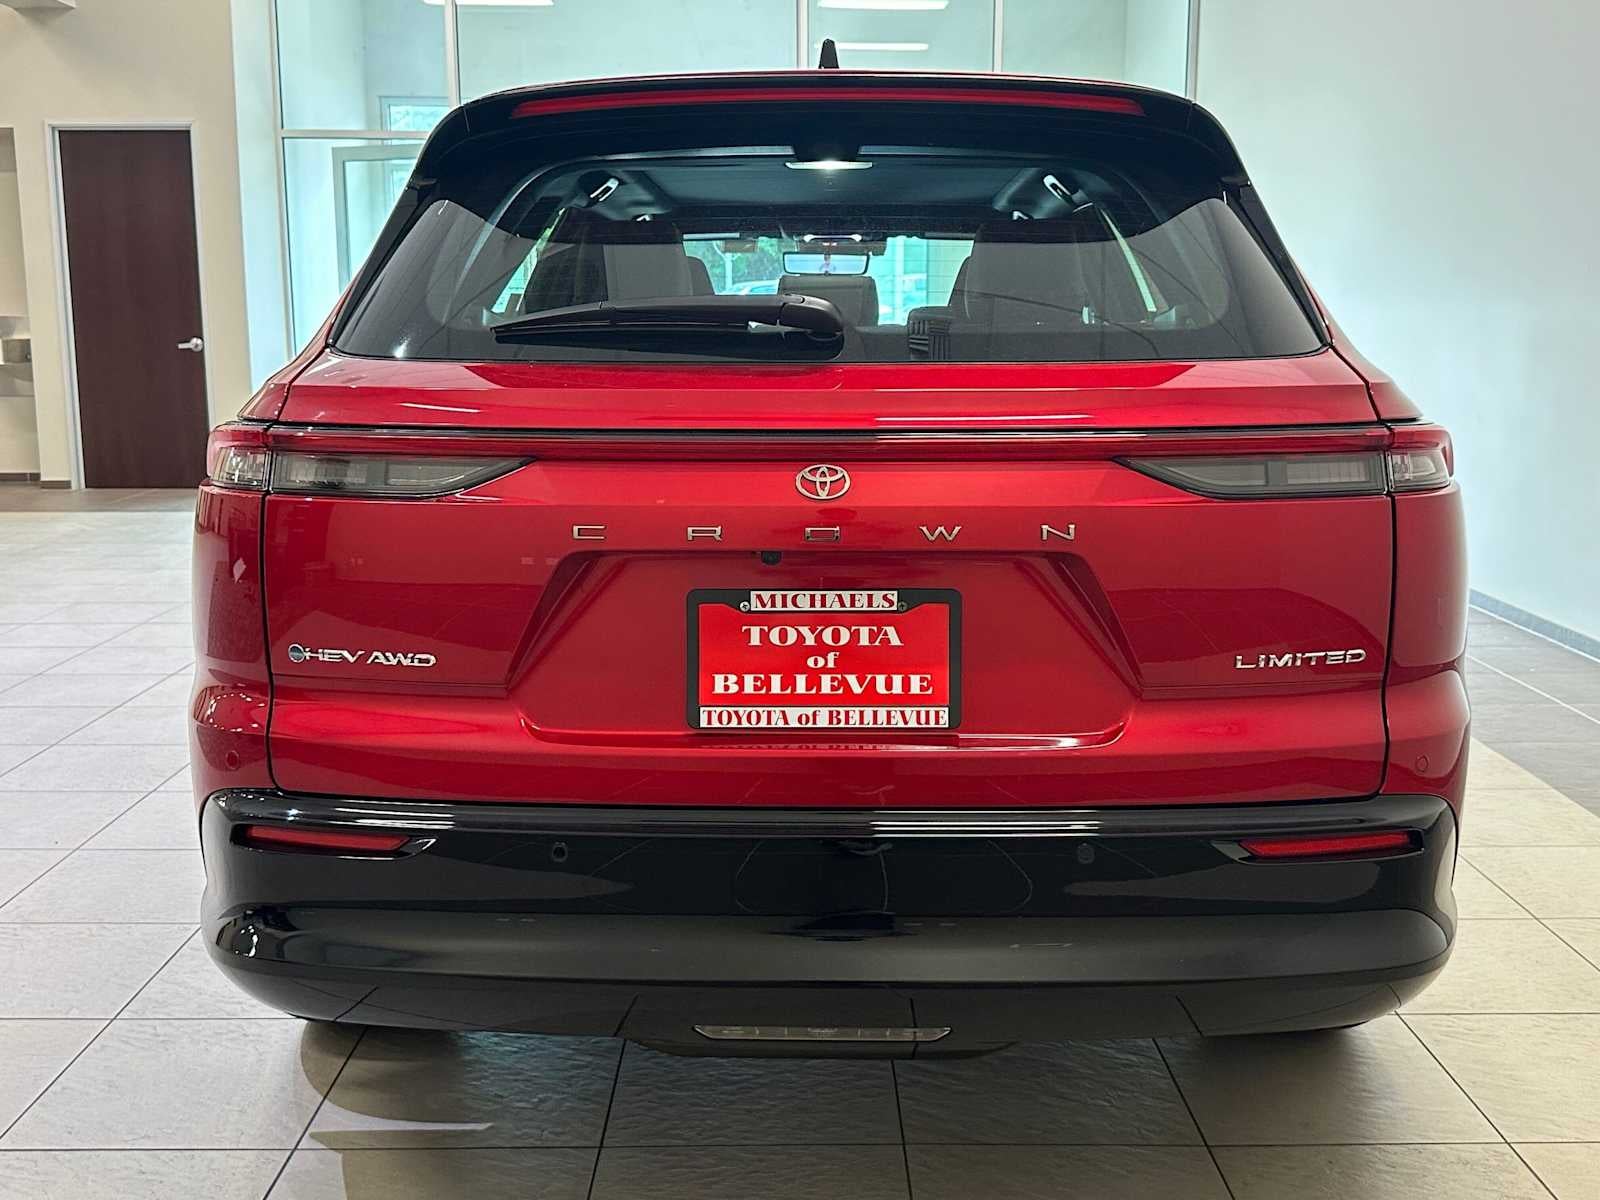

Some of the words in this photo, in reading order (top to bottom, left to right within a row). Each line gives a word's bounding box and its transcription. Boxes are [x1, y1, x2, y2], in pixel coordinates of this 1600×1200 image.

[572, 524, 1076, 544] CROWN
[754, 593, 897, 609] MICHAELS
[742, 625, 904, 647] TOYOTA
[367, 651, 437, 667] AWD
[806, 651, 840, 669] of
[1235, 648, 1367, 669] LIMITED
[712, 673, 933, 695] BELLEVUE
[702, 709, 790, 726] TOYOTA
[797, 709, 822, 726] of
[828, 709, 948, 726] BELLEVUE
